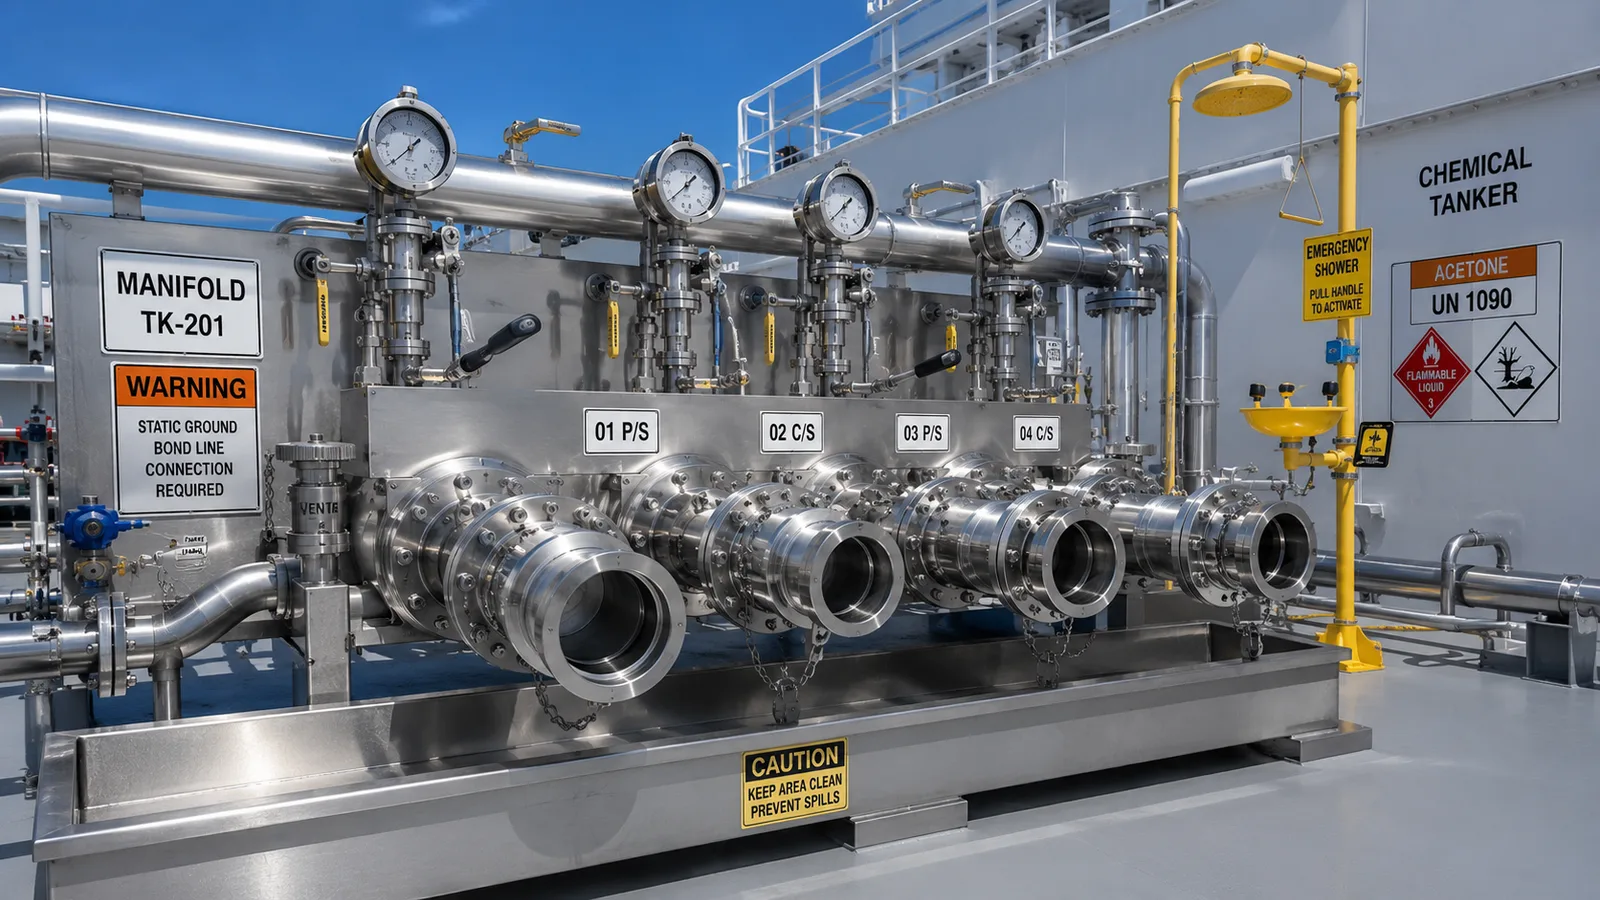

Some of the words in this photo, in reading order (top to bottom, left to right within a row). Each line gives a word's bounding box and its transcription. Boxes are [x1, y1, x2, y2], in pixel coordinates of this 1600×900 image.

[1419, 146, 1532, 188] CHEMICAL
[1430, 181, 1518, 216] TANKER
[1307, 236, 1369, 259] EMERGENCY
[1315, 258, 1359, 278] SHOWER
[1434, 255, 1508, 281] ACETONE
[117, 271, 246, 301] MANIFOLD
[1310, 287, 1330, 300] PULL
[1331, 283, 1364, 297] HANDLE
[1312, 302, 1322, 314] TO
[1324, 298, 1362, 313] ACTIVATE
[1432, 292, 1459, 315] UN
[1466, 287, 1512, 312] 1090
[141, 310, 223, 337] TK-201
[1406, 368, 1456, 381] FLAMMABLE
[126, 375, 246, 399] WARNING
[1418, 382, 1444, 393] LIQUID
[1428, 398, 1434, 409] 3
[138, 420, 181, 433] STATIC
[185, 420, 237, 434] GROUND
[595, 421, 614, 441] 01
[622, 421, 649, 441] P/S
[769, 423, 787, 441] 02
[791, 423, 815, 441] C/S
[904, 424, 919, 441] 03
[923, 424, 942, 441] P/S
[1020, 426, 1033, 441] 04
[1036, 426, 1054, 441] C/S
[154, 441, 191, 454] BOND
[196, 441, 224, 454] LINE
[146, 462, 233, 476] CONNECTION
[156, 483, 224, 498] REQUIRED
[752, 746, 838, 777] CAUTION
[748, 784, 776, 801] KEEP
[779, 779, 806, 796] AREA
[810, 773, 842, 790] CLEAN
[751, 798, 801, 819] PREVENT
[804, 790, 840, 809] SPILLS
